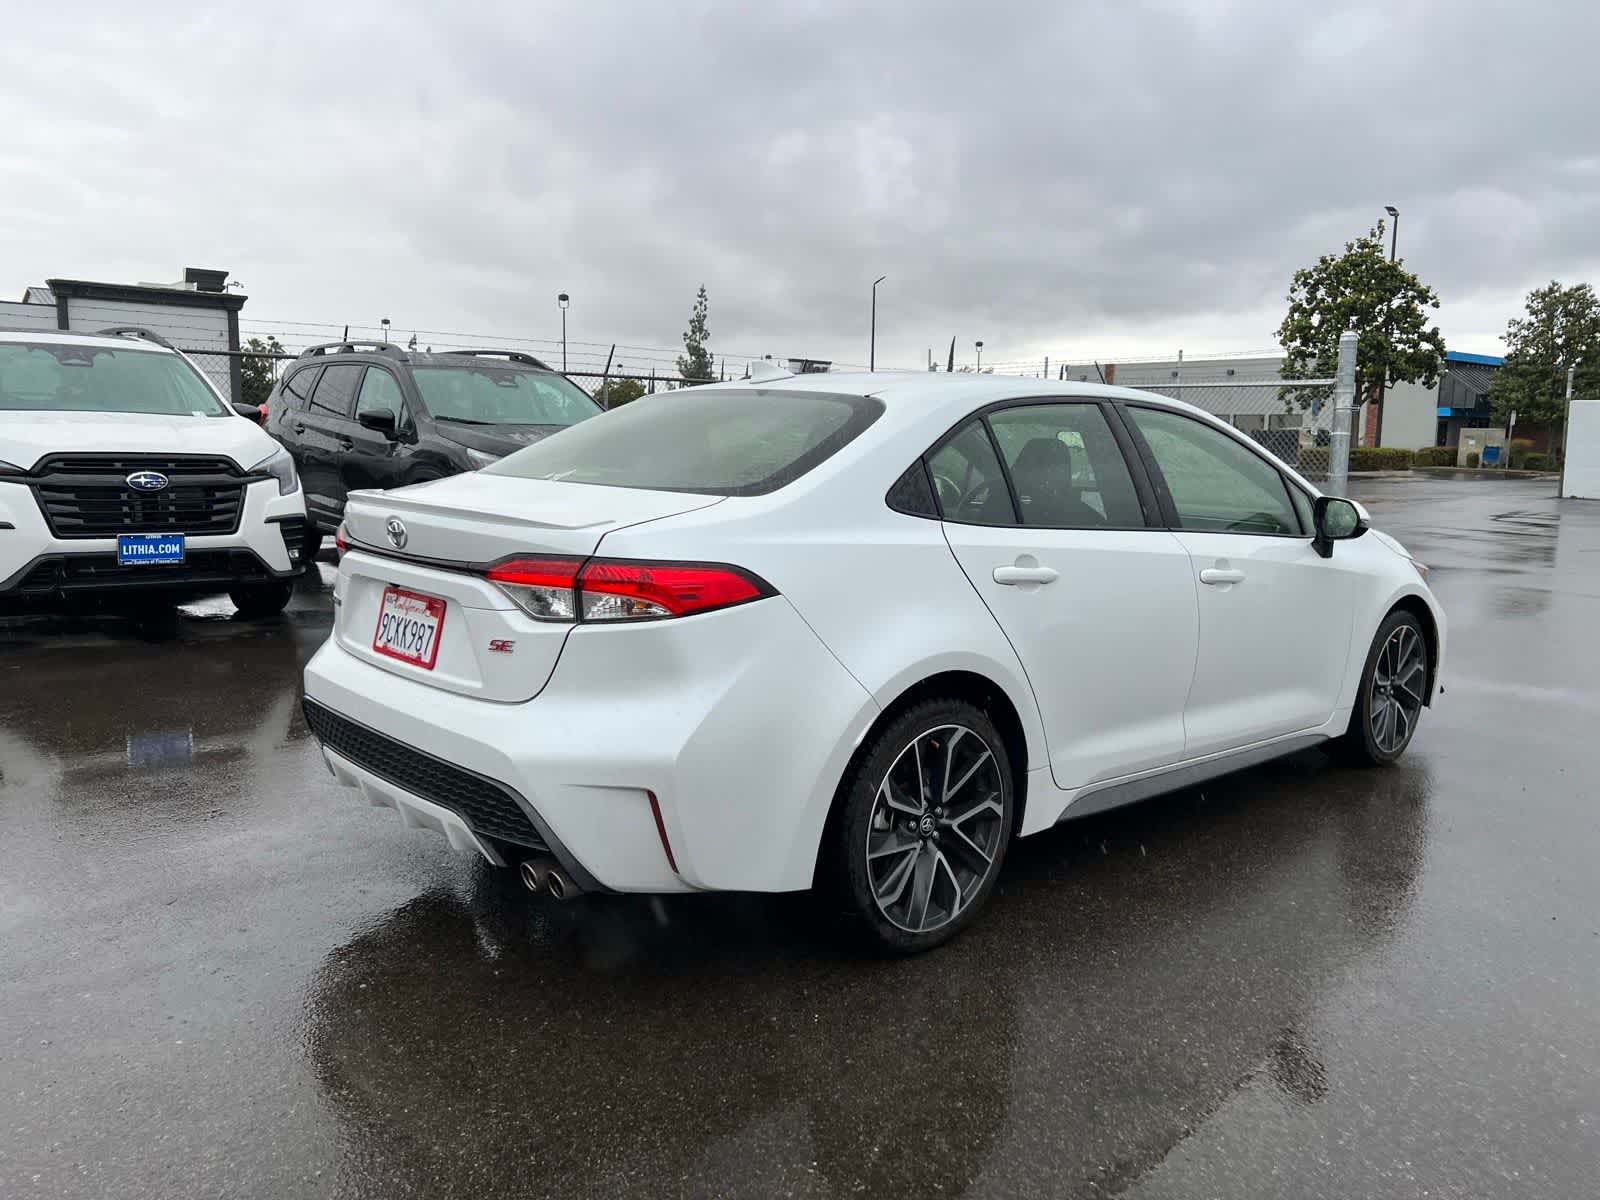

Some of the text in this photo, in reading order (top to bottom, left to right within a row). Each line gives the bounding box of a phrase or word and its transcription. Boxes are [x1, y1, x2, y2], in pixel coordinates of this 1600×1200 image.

[123, 543, 180, 555] LITHIA.COM
[379, 613, 435, 656] 9CKK987
[488, 639, 515, 652] SE
